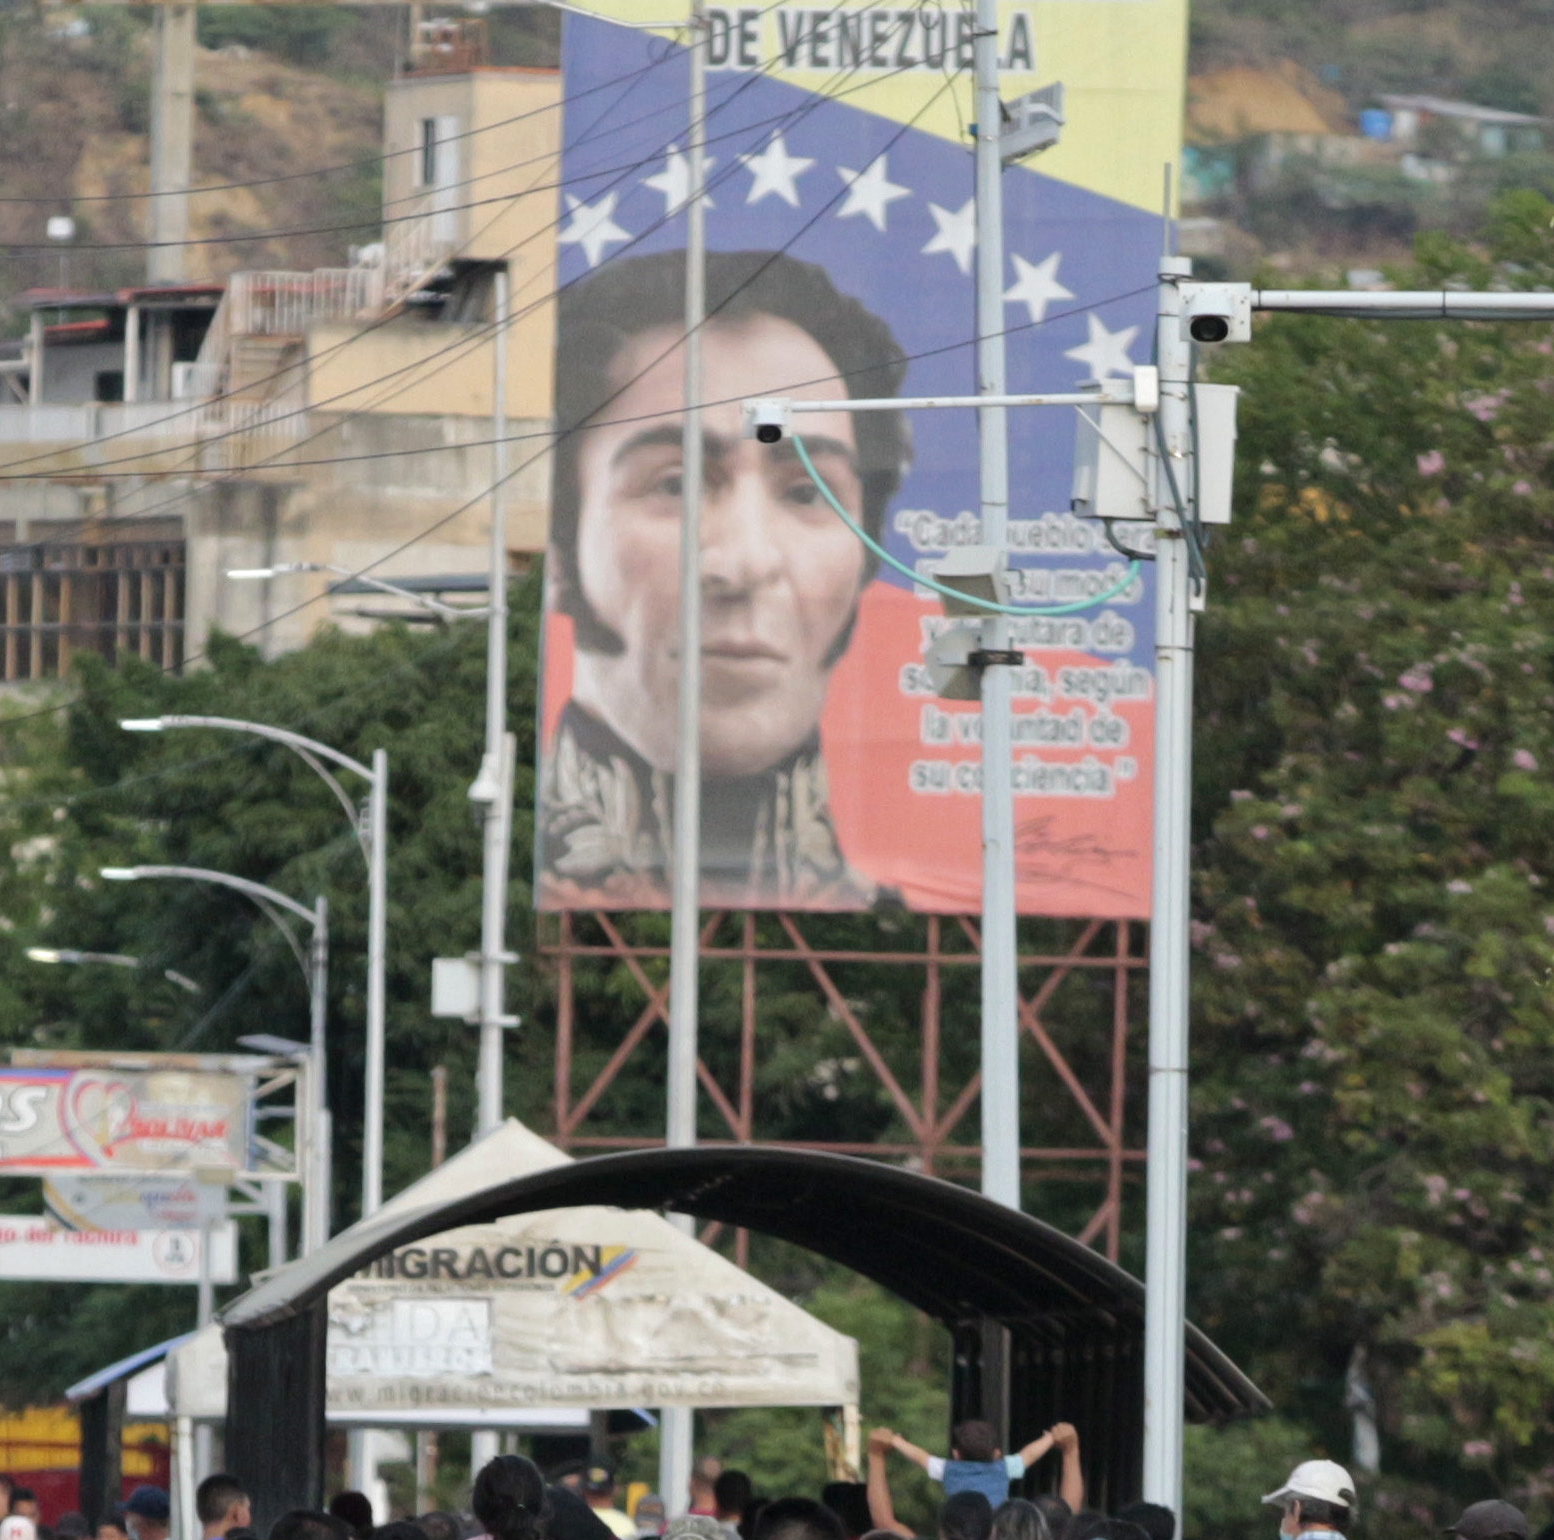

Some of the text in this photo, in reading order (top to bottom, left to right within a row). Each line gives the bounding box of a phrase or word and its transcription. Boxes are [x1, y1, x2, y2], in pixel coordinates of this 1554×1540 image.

[706, 9, 1035, 70] DE VENEZUEA
[1007, 514, 1092, 549] ueblo
